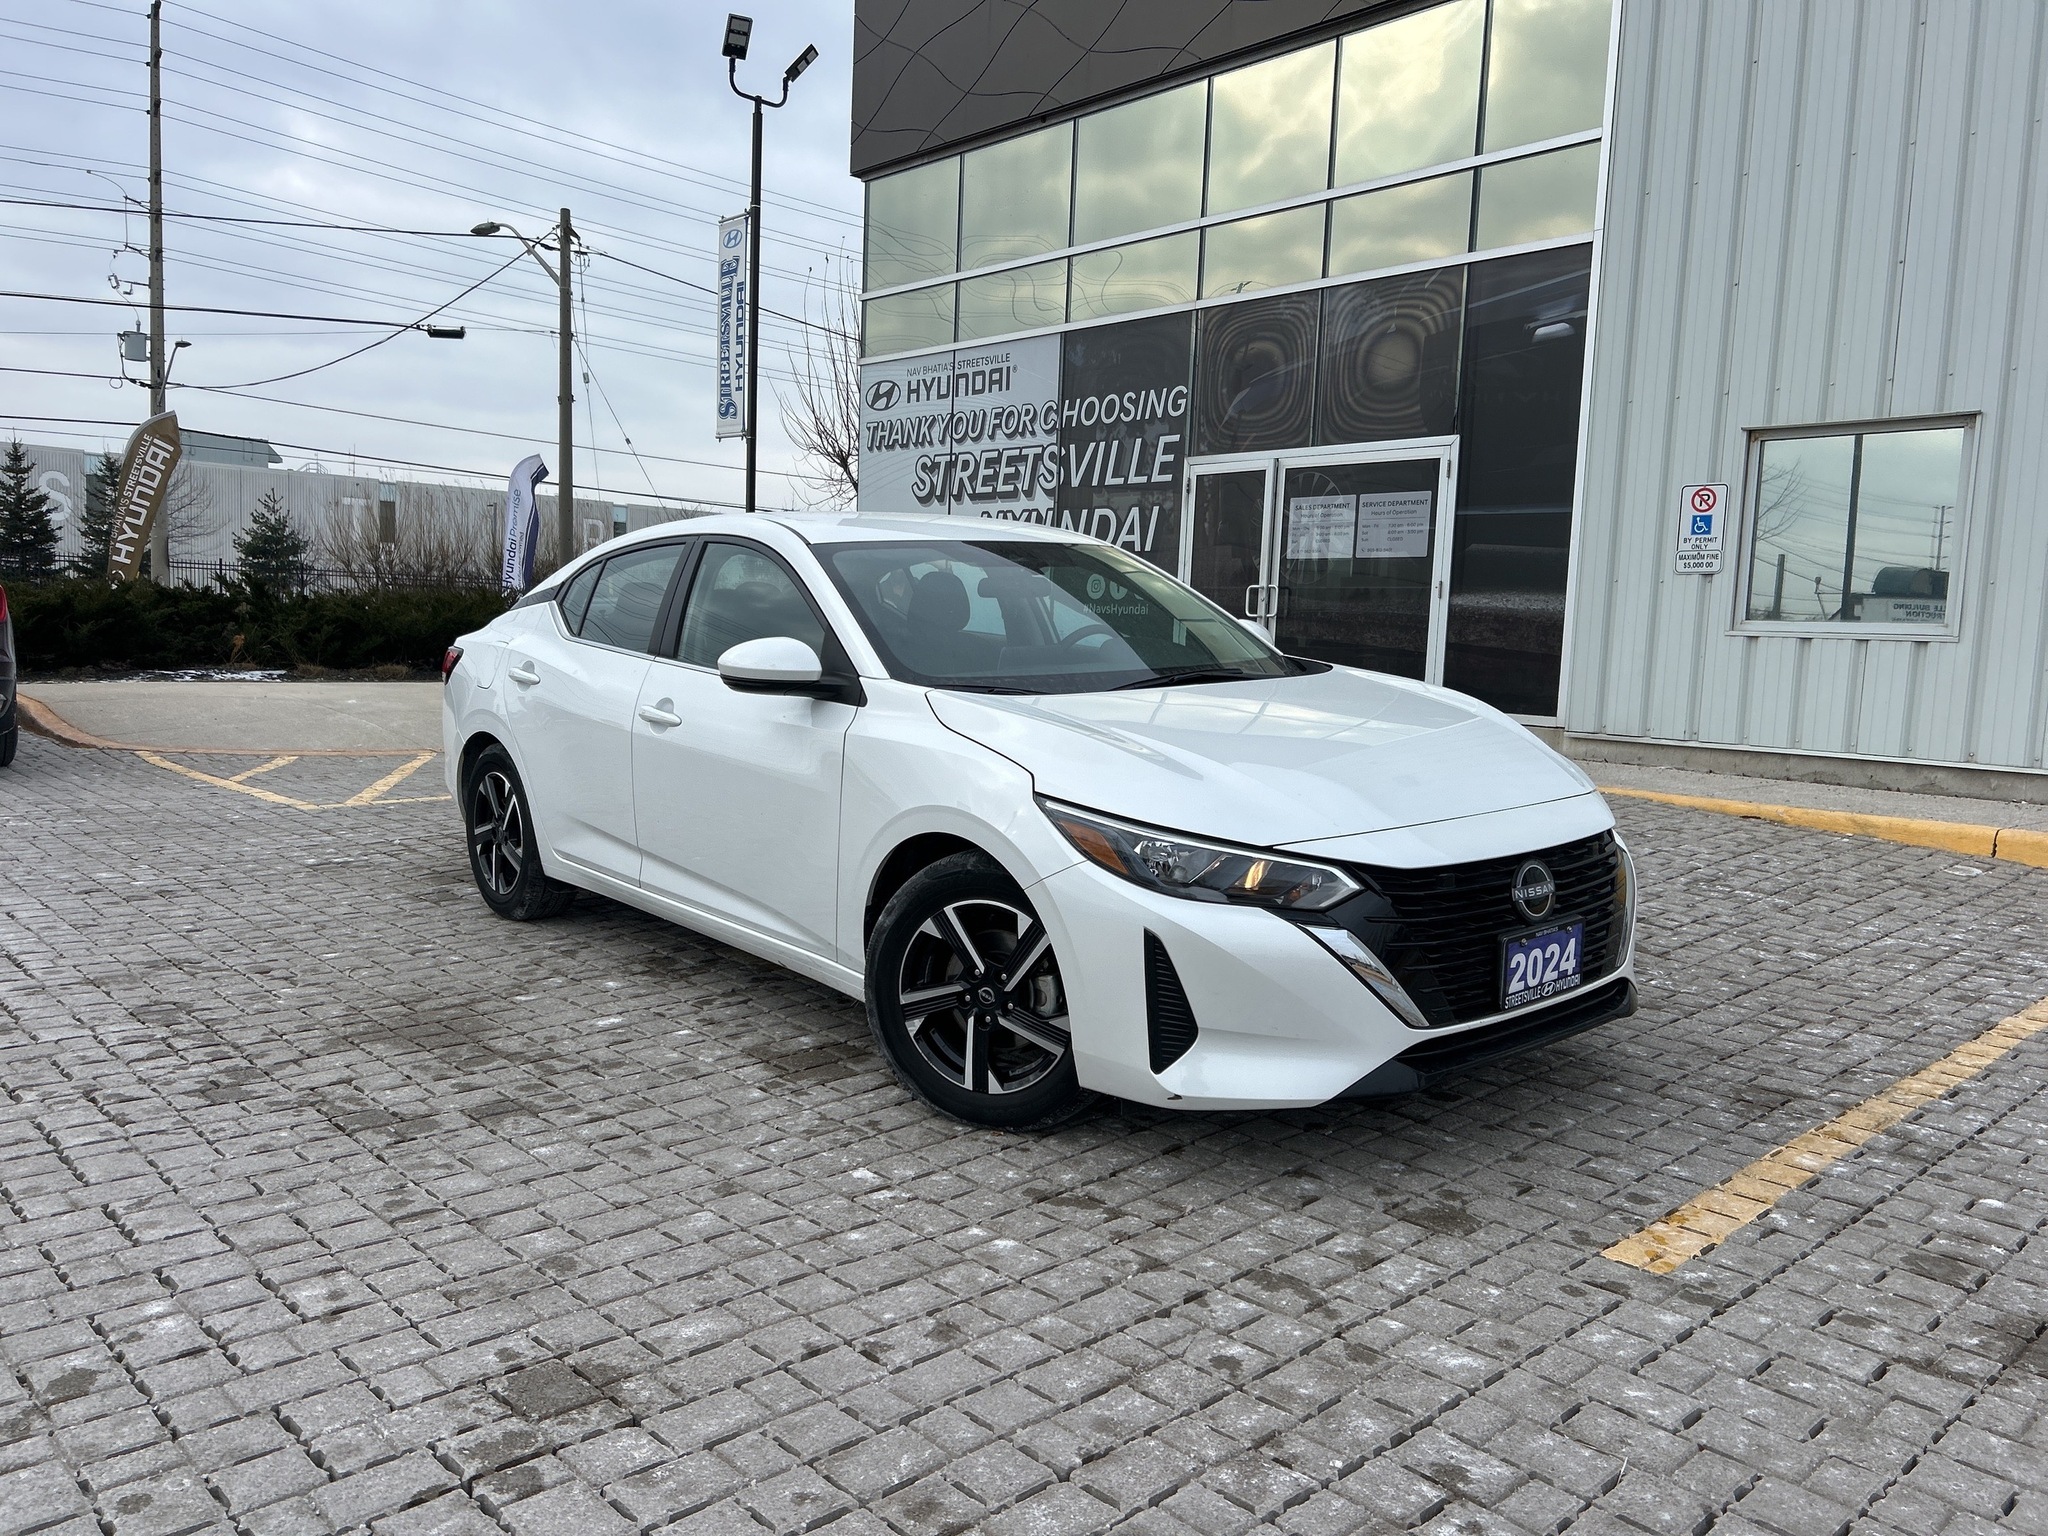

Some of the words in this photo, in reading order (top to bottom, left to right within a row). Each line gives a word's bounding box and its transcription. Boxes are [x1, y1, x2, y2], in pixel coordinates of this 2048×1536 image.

[719, 255, 740, 420] STREETSVILLE
[735, 281, 745, 392] HYUNDAI
[906, 366, 922, 378] NAV
[922, 361, 954, 376] BHATIA'S
[957, 352, 1011, 370] STREETSVILLE
[866, 413, 936, 452] THANK
[937, 408, 986, 443] YOU
[988, 402, 1037, 438] FOR
[1039, 384, 1188, 431] CHOOSING
[123, 433, 153, 497] STREETSVILLE
[911, 433, 1182, 503] STREETSVILLE
[112, 437, 175, 565] HYUNDAI
[509, 488, 522, 538] Promise
[1295, 504, 1312, 512] SALES
[1313, 502, 1351, 511] DEPARTMENT
[1361, 500, 1386, 508] SERVICE
[1387, 499, 1429, 507] DEPARTMENT
[501, 537, 518, 591] Hyundai
[1678, 553, 1705, 561] MAXIMUM
[1695, 536, 1718, 544] PERMIT
[1514, 883, 1554, 899] NISSAN
[1504, 985, 1541, 1009] STREETSVILLE
[1555, 973, 1581, 992] HYUNDAI
[1508, 937, 1576, 995] 2024
